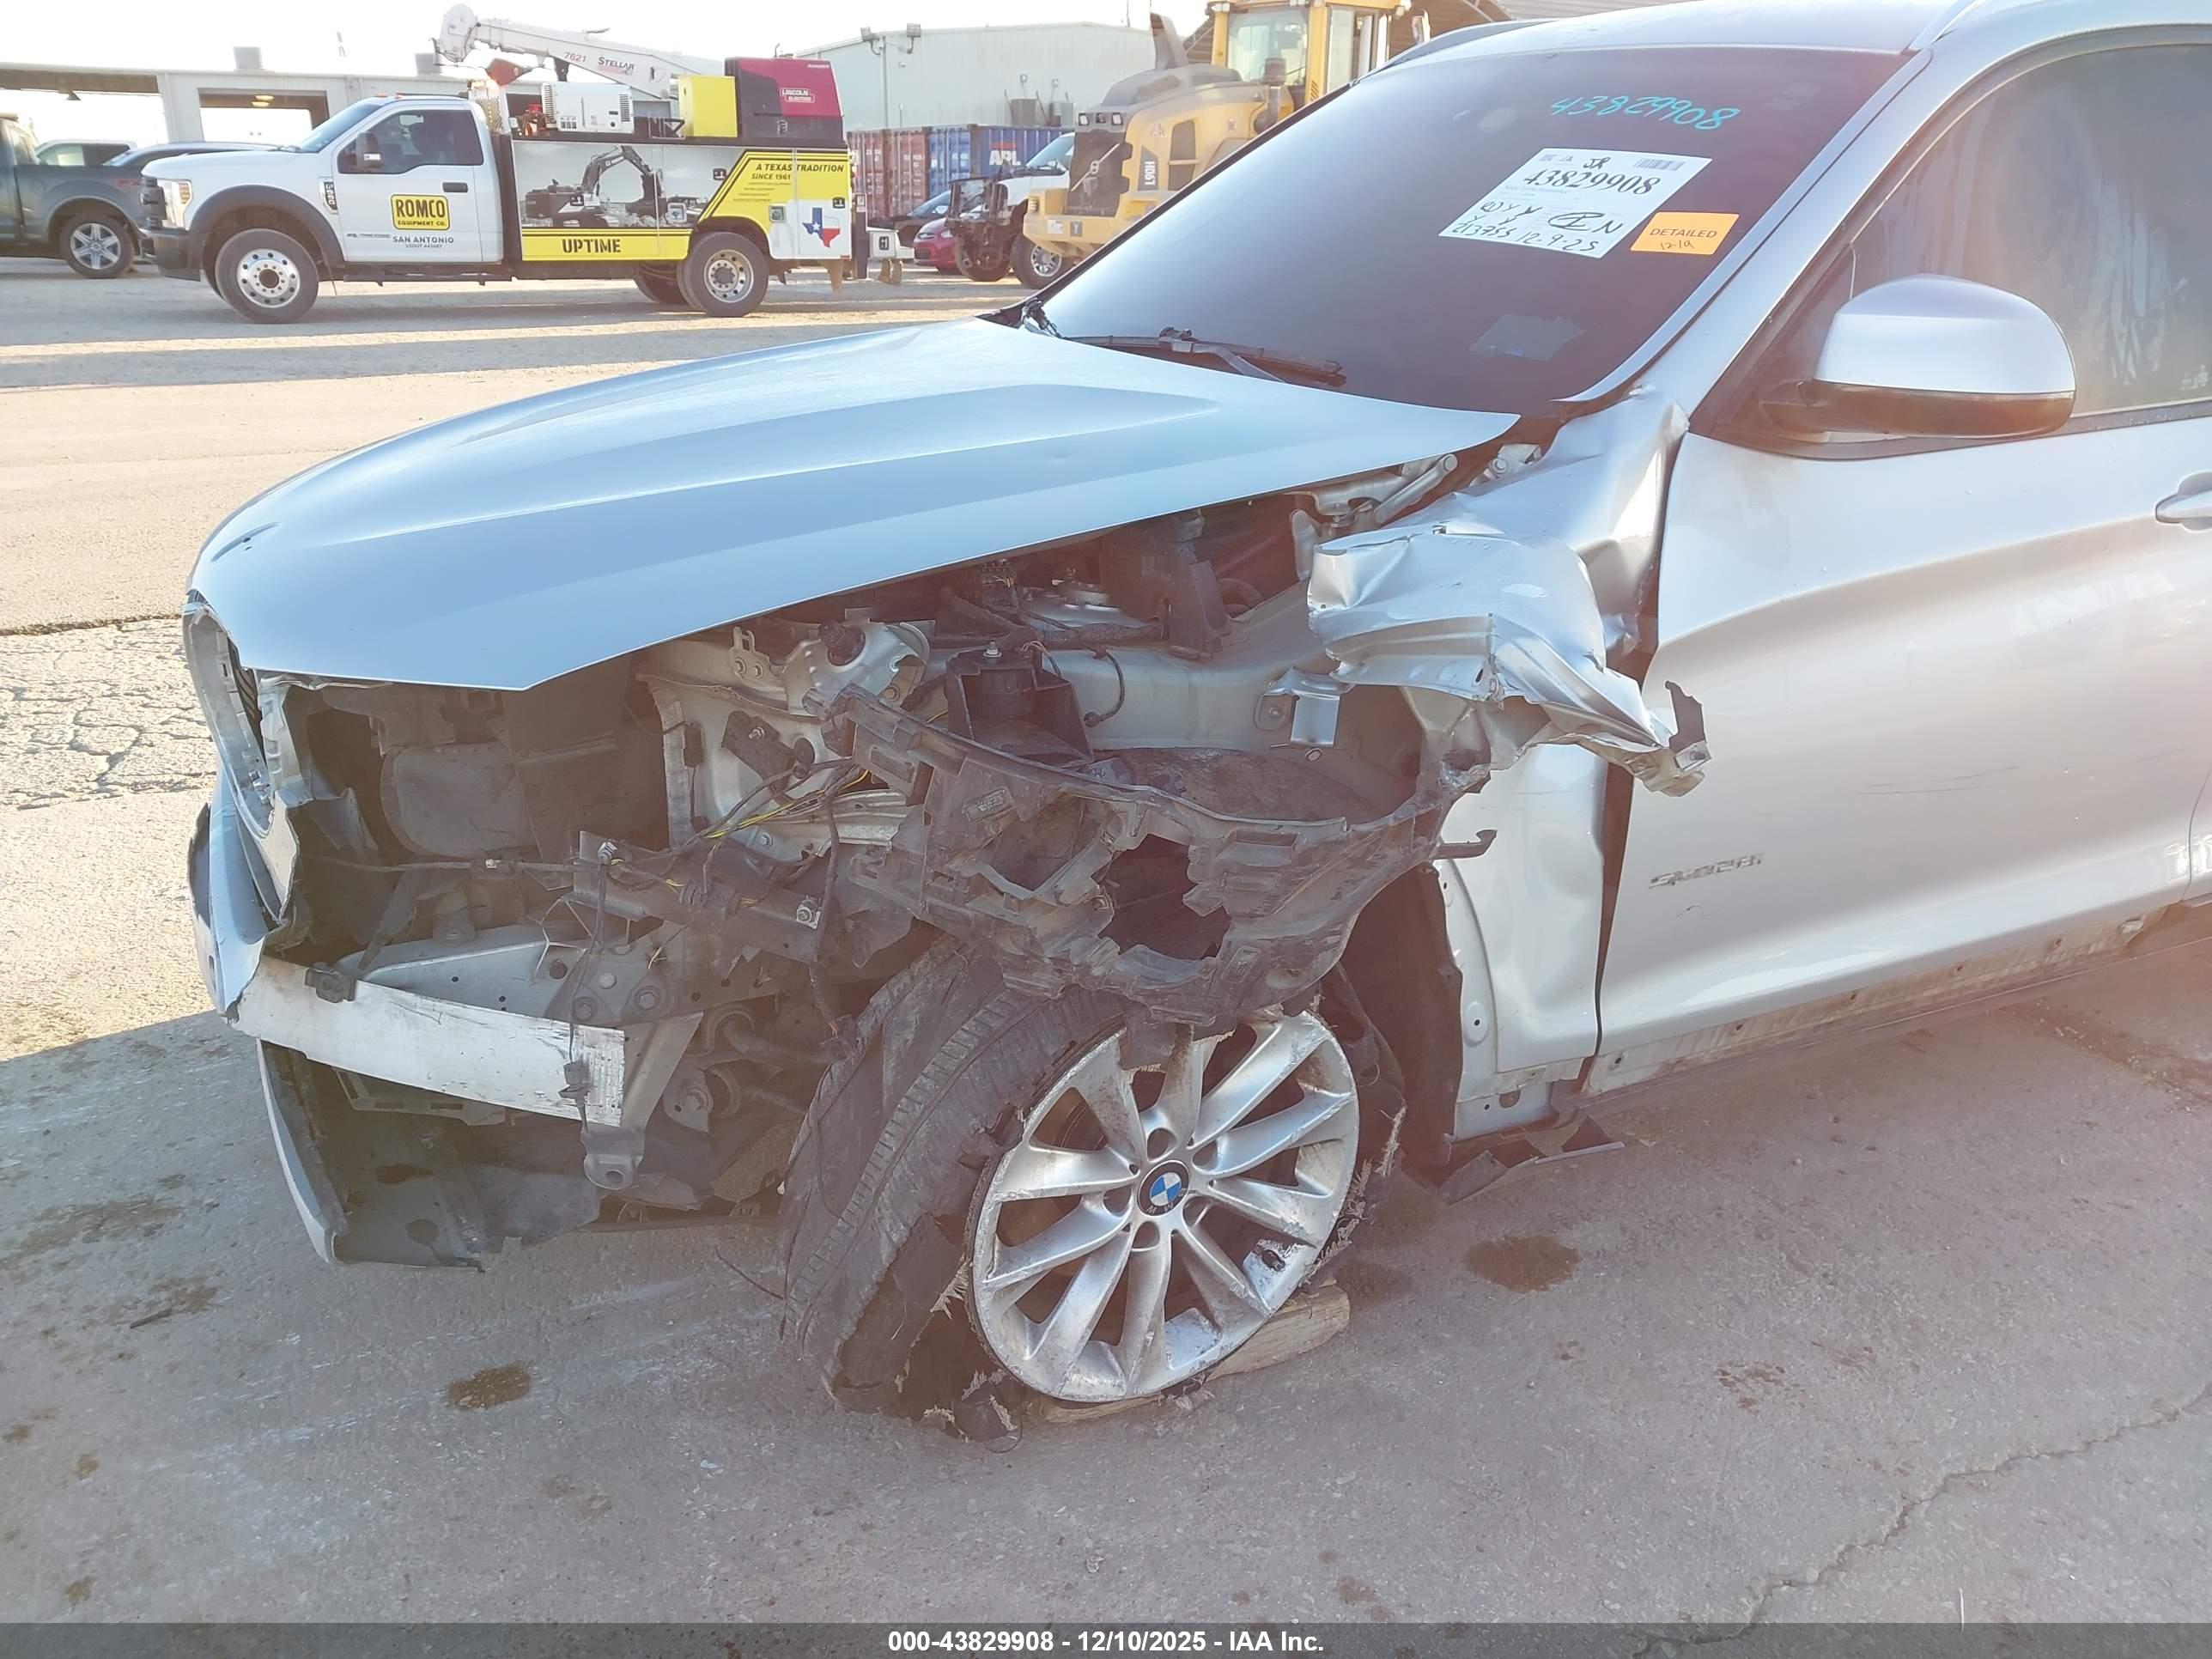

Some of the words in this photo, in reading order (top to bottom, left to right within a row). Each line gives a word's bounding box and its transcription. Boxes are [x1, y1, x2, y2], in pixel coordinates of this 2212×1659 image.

[564, 52, 586, 63] 7621
[1551, 95, 1741, 130] 43829908
[765, 163, 793, 172] TEXAS
[796, 164, 845, 173] TRADITION
[1144, 161, 1156, 185] L90H
[1523, 169, 1662, 195] 43829908
[396, 199, 445, 217] ROMCO
[1650, 228, 1717, 238] DETAILED
[562, 239, 621, 253] UPTIME
